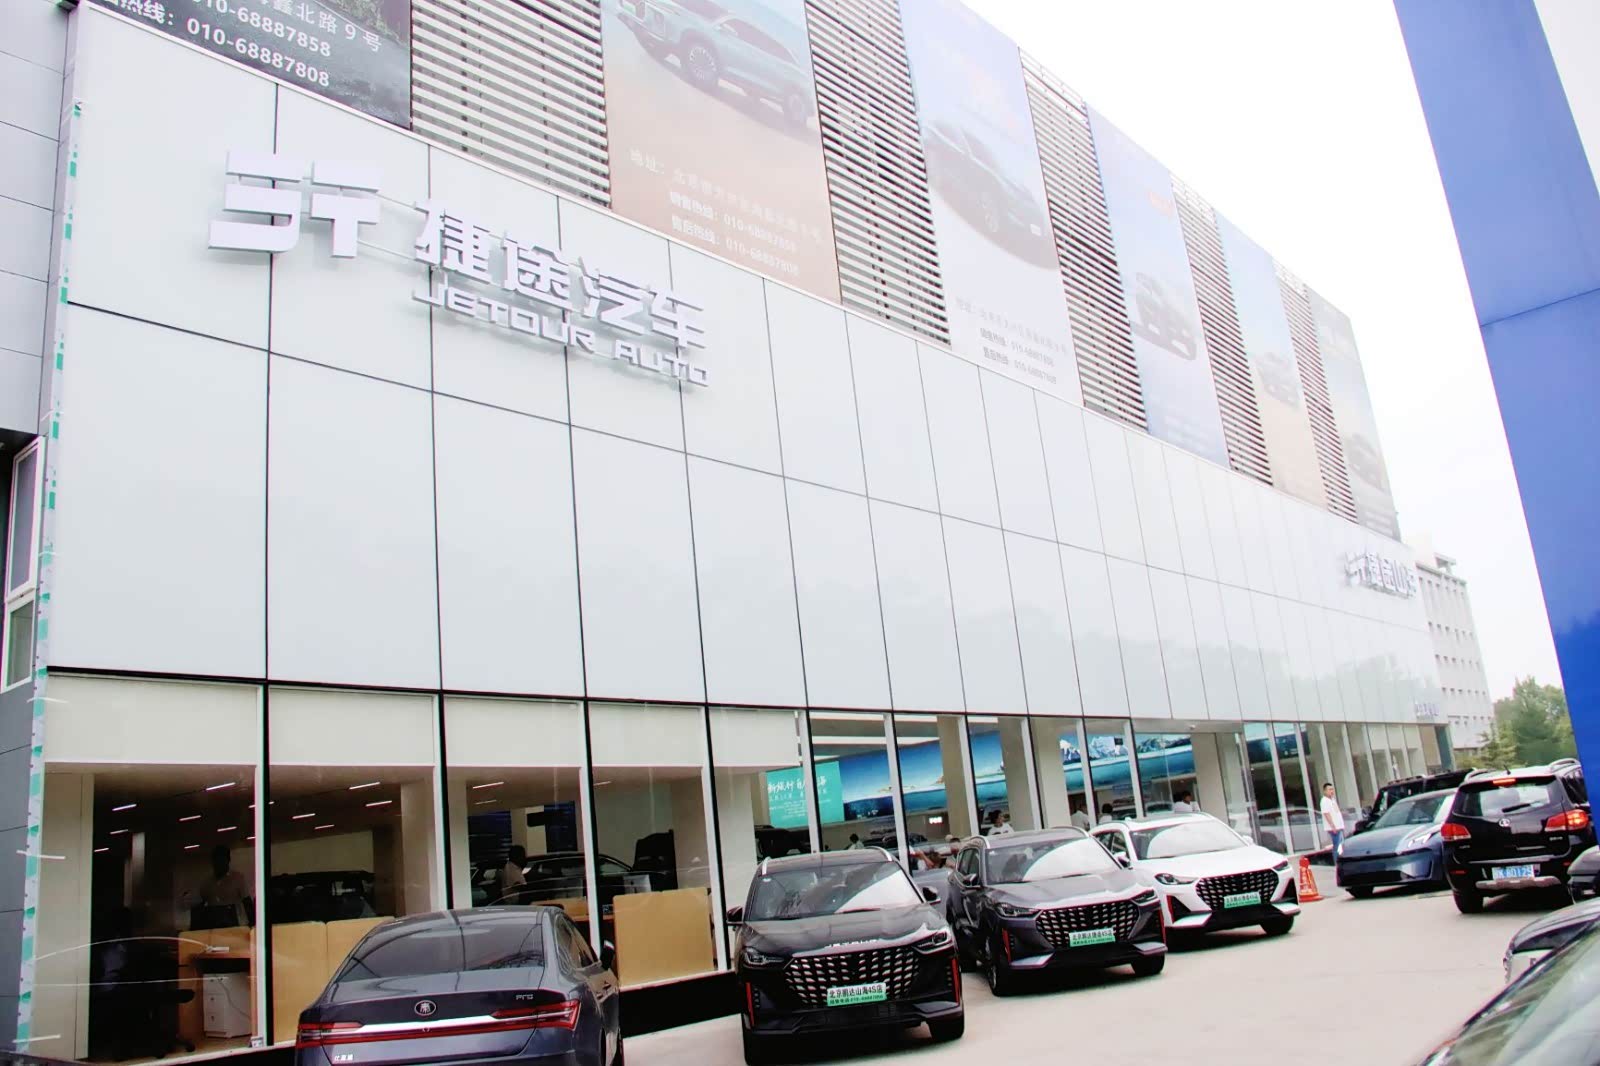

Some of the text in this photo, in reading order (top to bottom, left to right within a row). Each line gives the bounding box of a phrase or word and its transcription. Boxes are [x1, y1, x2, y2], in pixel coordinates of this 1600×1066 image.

[187, 18, 330, 87] 010-68887808
[413, 200, 707, 350] 捷途汽车
[412, 283, 710, 387] JETOUR AUTO
